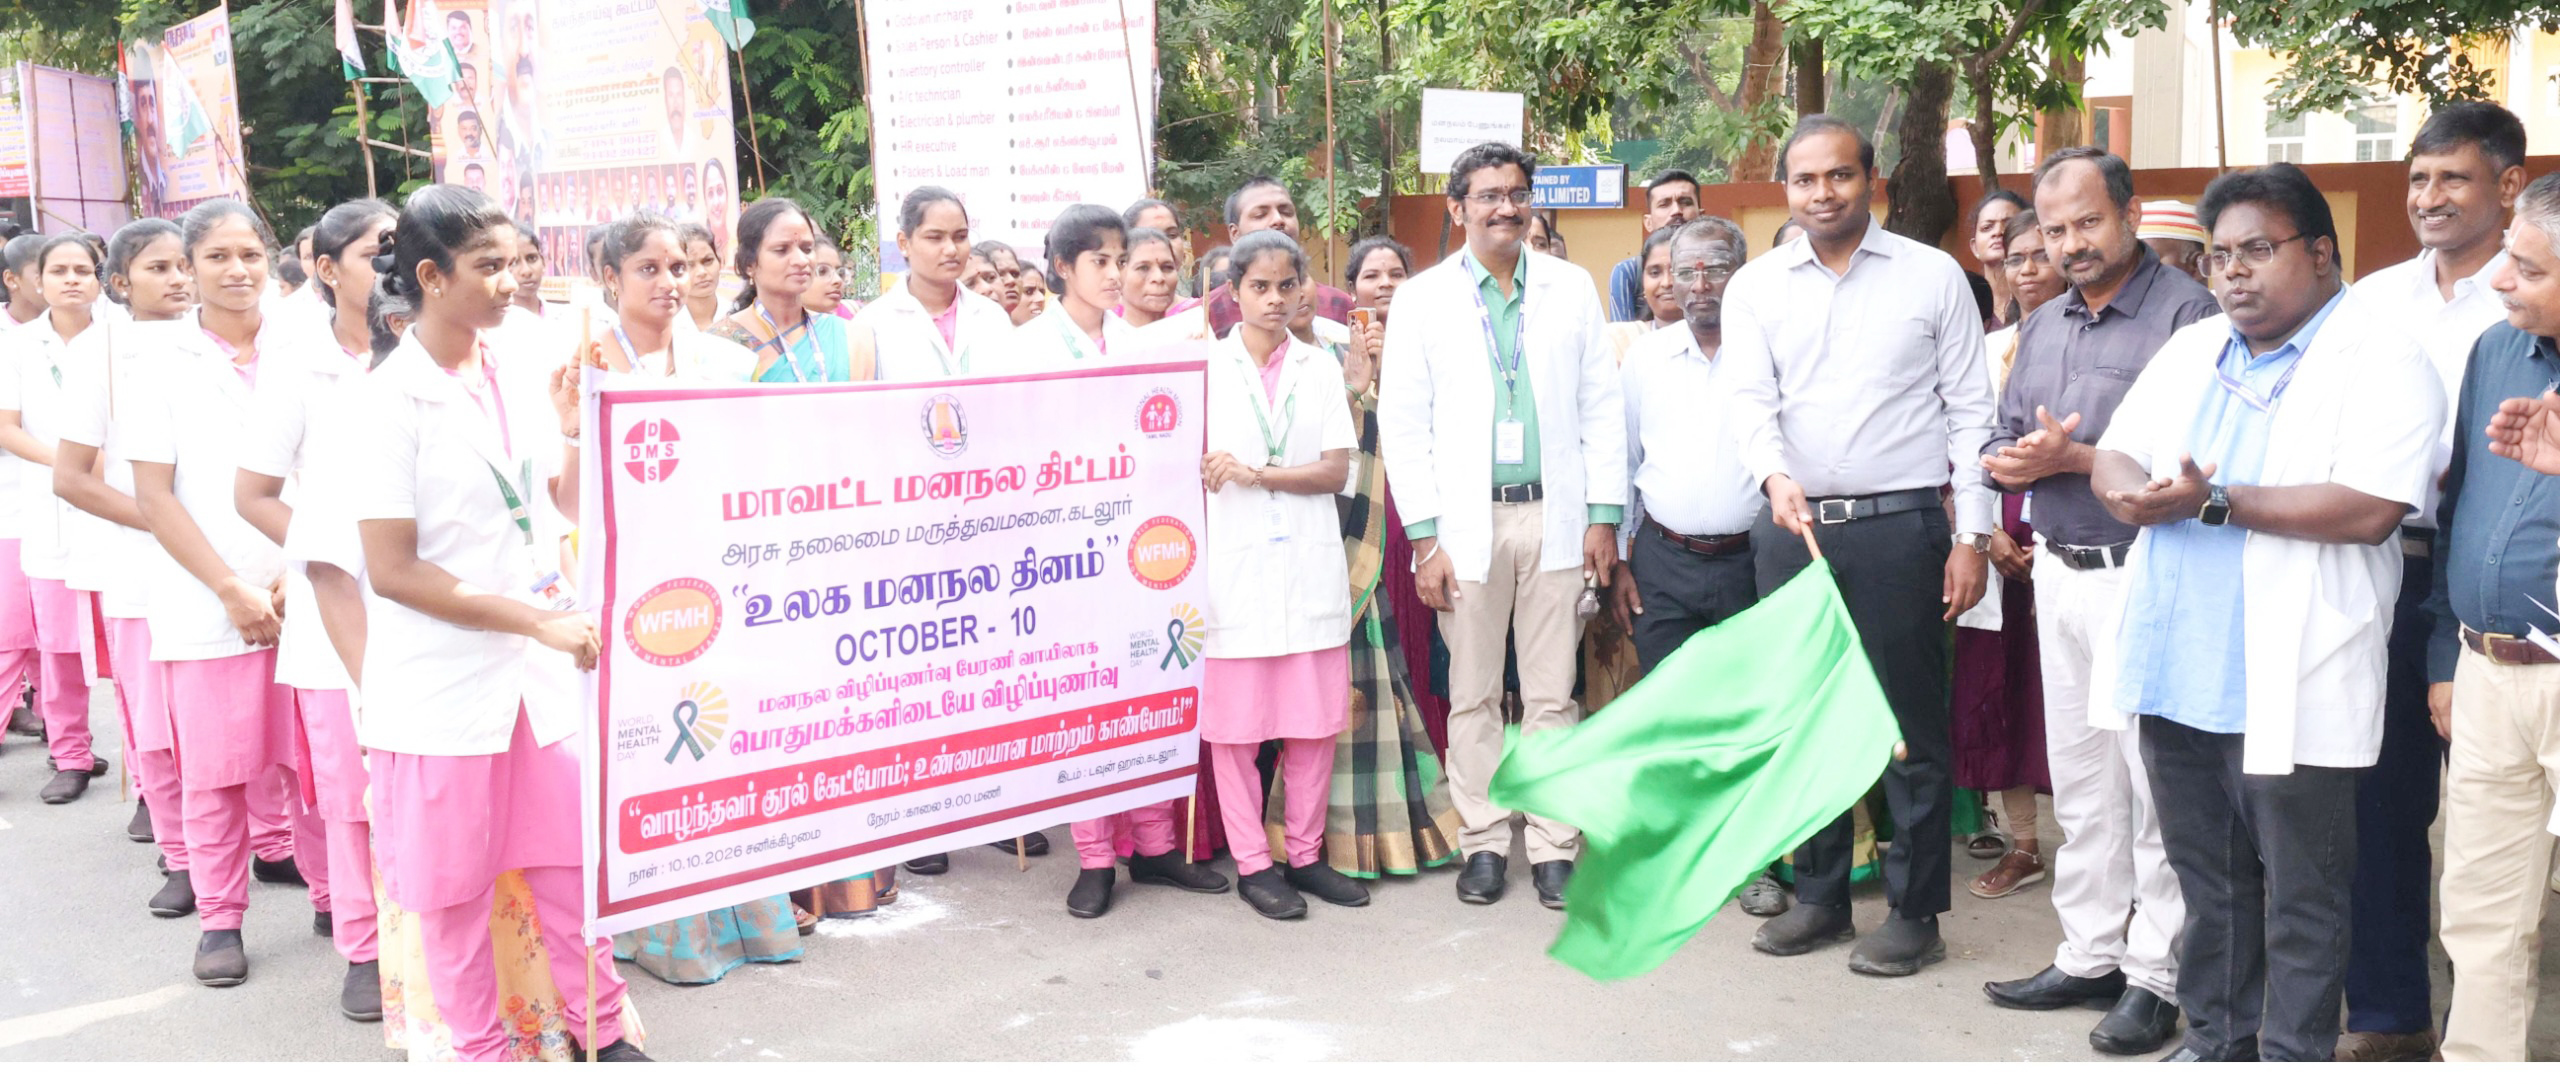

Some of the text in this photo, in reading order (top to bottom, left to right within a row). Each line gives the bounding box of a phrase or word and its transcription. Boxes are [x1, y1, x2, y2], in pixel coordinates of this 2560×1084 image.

[920, 36, 951, 50] Person
[954, 34, 960, 48] &
[962, 30, 999, 46] Cashier
[897, 60, 985, 79] Inventory controller
[915, 88, 961, 102] technician
[900, 113, 995, 128] Electrician & plumber
[900, 140, 957, 153] HR executive
[901, 164, 990, 177] Packers & Load man
[1532, 174, 1570, 185] TAINED BY
[1548, 186, 1590, 204] LIMITED
[722, 443, 1136, 522] மாவட்ட மனநல திட்டம்
[721, 543, 782, 569] அரசு
[786, 528, 900, 566] தலைமை
[1137, 540, 1187, 564] WFMH
[732, 583, 852, 628] “உலக
[864, 563, 1001, 611] மனநல
[638, 604, 710, 635] WFMH
[835, 605, 1036, 667] OCTOBER - 10
[1129, 629, 1154, 640] WORLD
[1130, 637, 1160, 650] MENTAL
[1130, 647, 1158, 659] HEALTH
[1130, 658, 1143, 668] DAY
[758, 641, 1099, 714] மனநல விழிப்புணர்வு பேரணி வாயிலாக
[729, 660, 1119, 755] பொதுமக்களிடையே விழிப்புணர்வு
[617, 714, 654, 728] WORLD
[617, 724, 662, 740] MENTAL
[617, 735, 660, 751] HEALTH
[616, 750, 636, 762] DAY
[761, 771, 809, 818] குரல்
[813, 753, 910, 803] கேட்போம்;
[913, 743, 1028, 781] உண்மையான
[1030, 714, 1096, 759] மாற்றம்
[1057, 767, 1082, 784] இடம்
[1088, 760, 1116, 778] டவுன்
[866, 807, 900, 830] நேரம்
[943, 792, 972, 810] 9.00
[974, 785, 1002, 804] மணி
[628, 863, 659, 888] நாள்
[668, 844, 743, 872] 10.10.2026
[746, 828, 822, 850] சனிக்கிழமை
